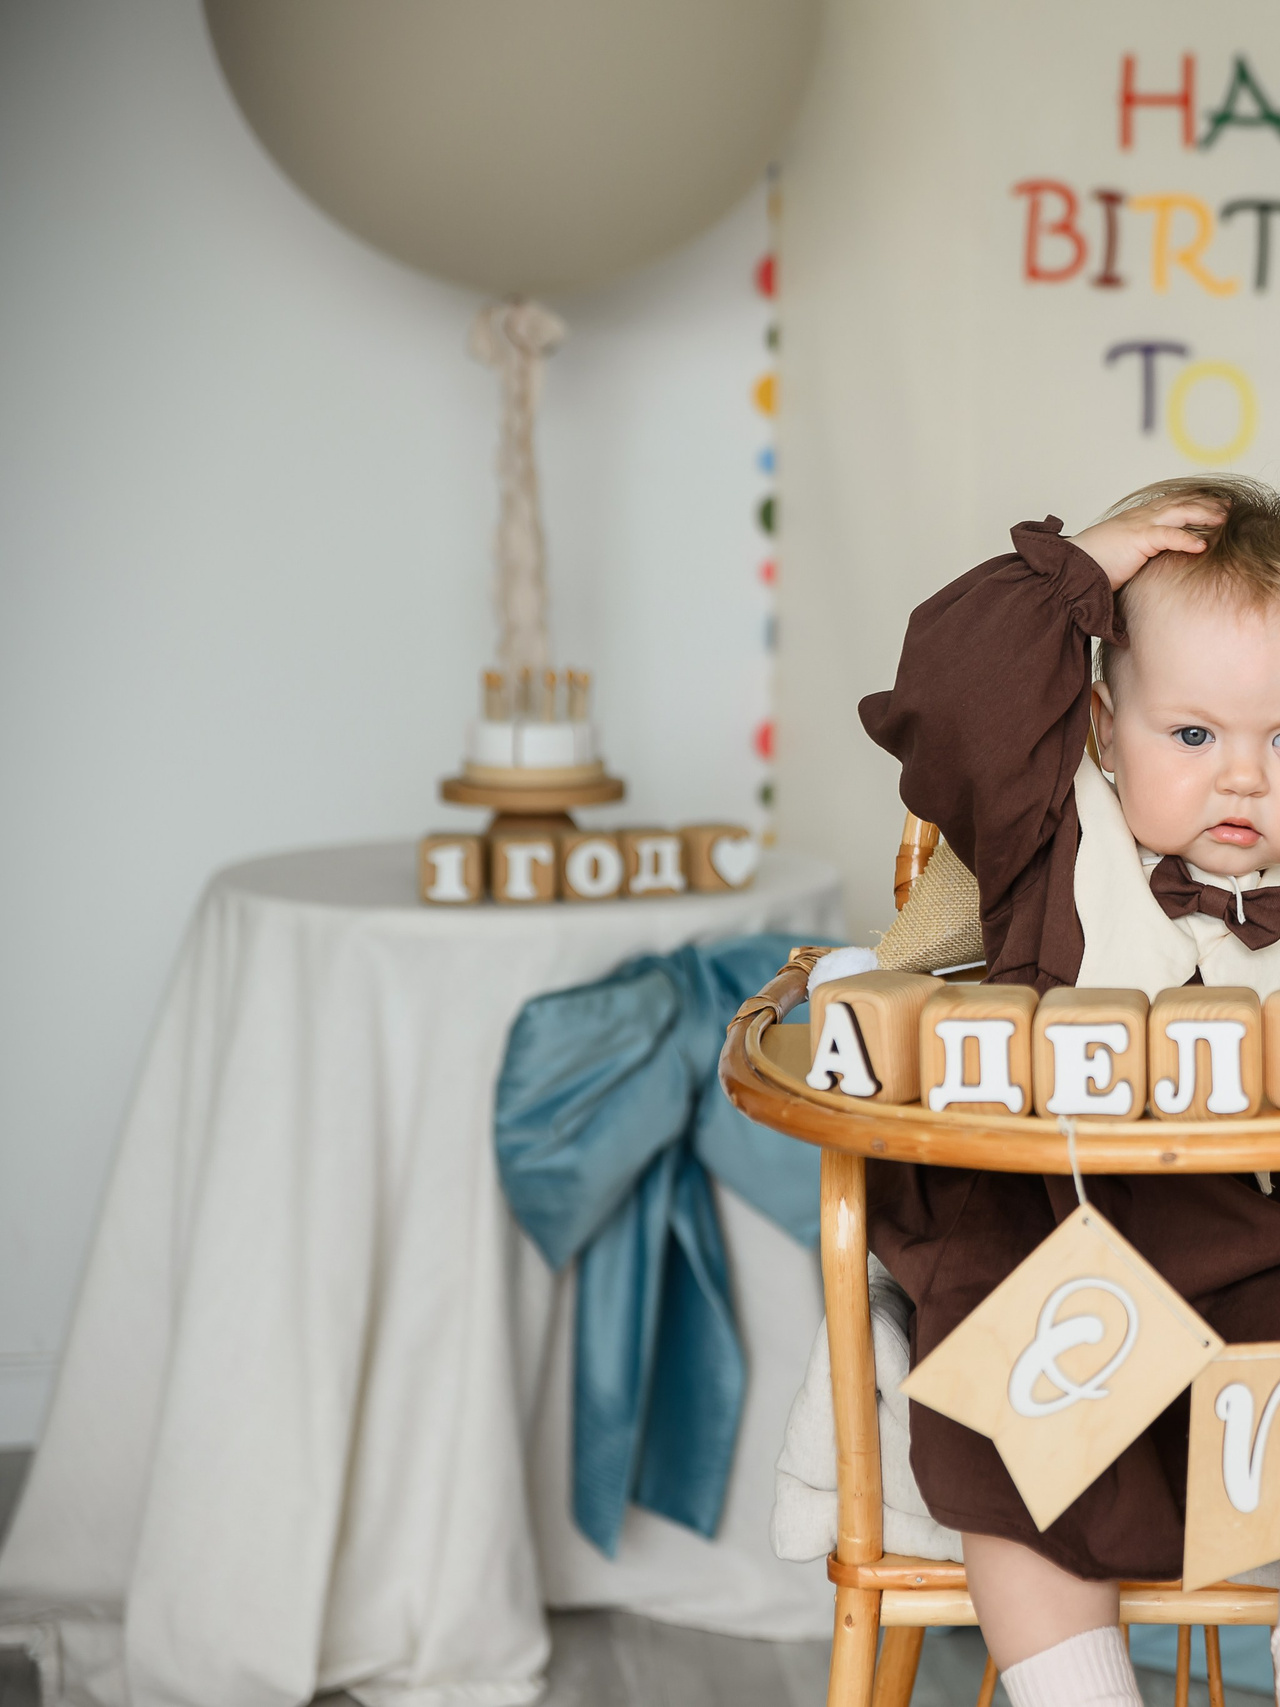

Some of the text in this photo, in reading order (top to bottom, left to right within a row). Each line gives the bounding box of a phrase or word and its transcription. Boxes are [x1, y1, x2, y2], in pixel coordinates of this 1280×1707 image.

[1103, 339, 1259, 467] TO
[427, 836, 688, 902] 1 ГОД
